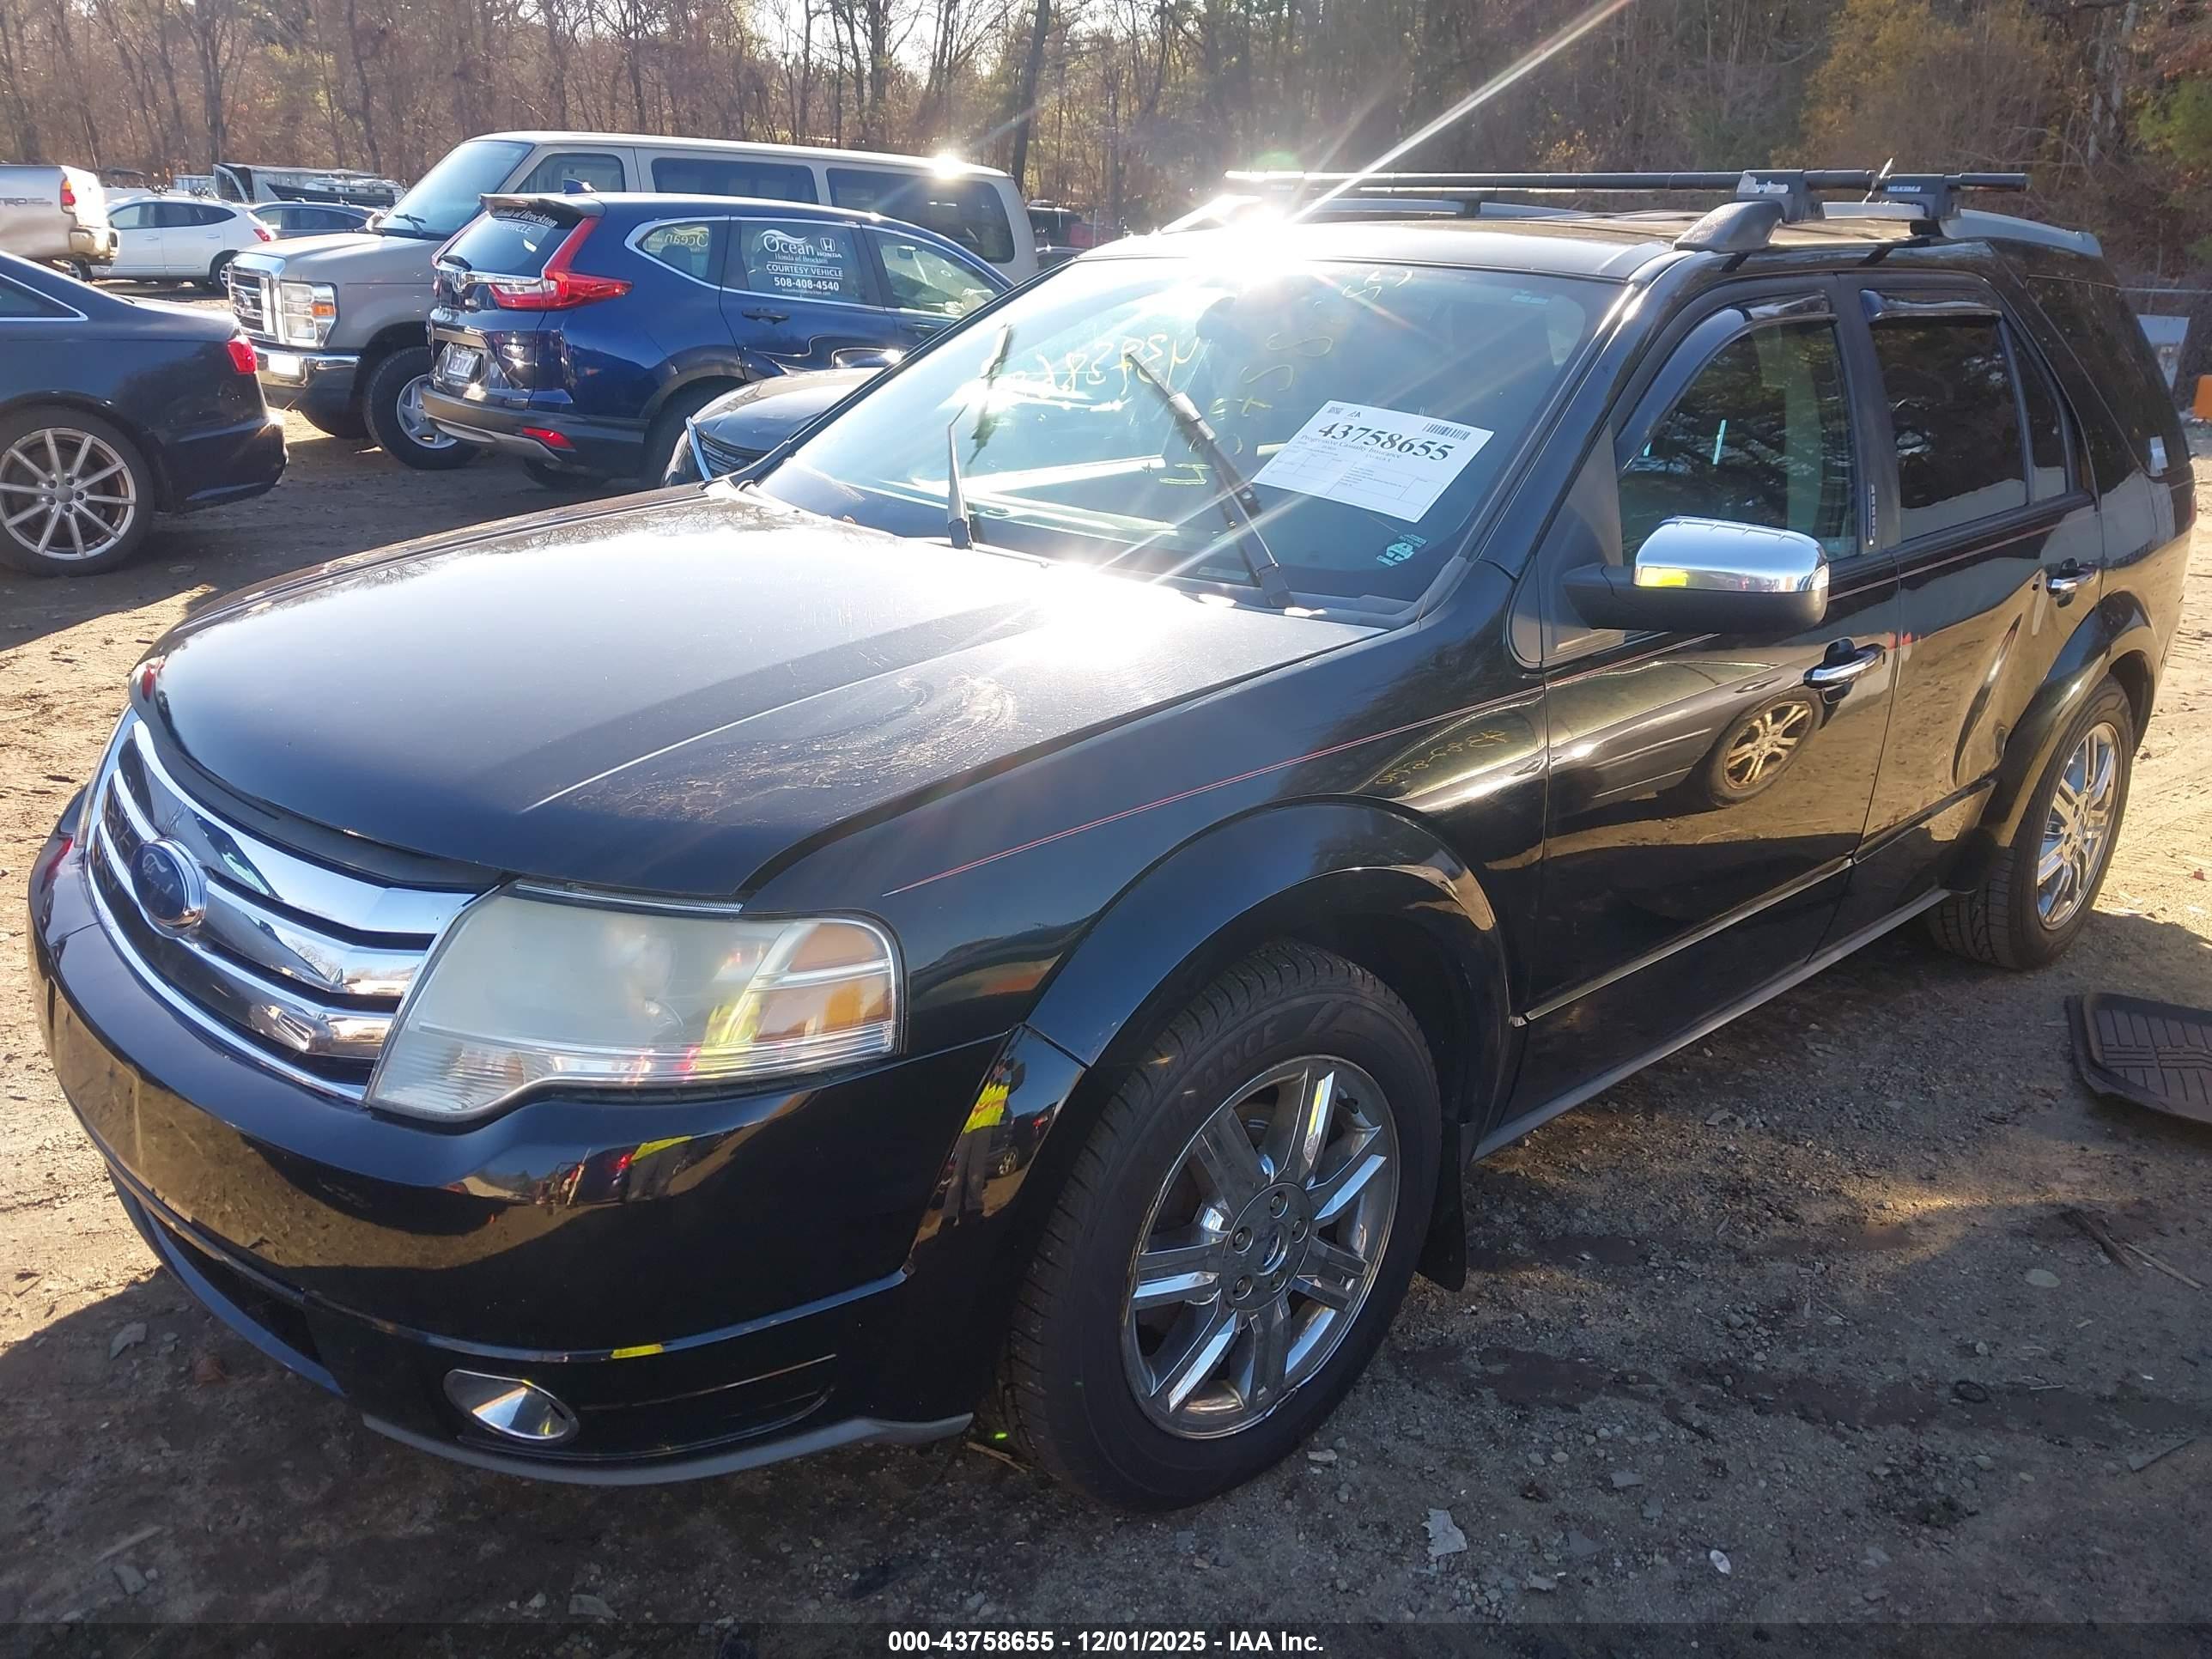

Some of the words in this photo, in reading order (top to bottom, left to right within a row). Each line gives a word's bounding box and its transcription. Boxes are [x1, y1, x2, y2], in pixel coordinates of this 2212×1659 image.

[520, 210, 559, 228] Brockton
[763, 234, 815, 256] Ocean
[775, 252, 795, 262] Honda
[766, 264, 809, 274] COURTESY
[810, 268, 844, 277] VEHICLE
[774, 276, 840, 291] 508-408-4540
[1317, 422, 1455, 461] 43758655
